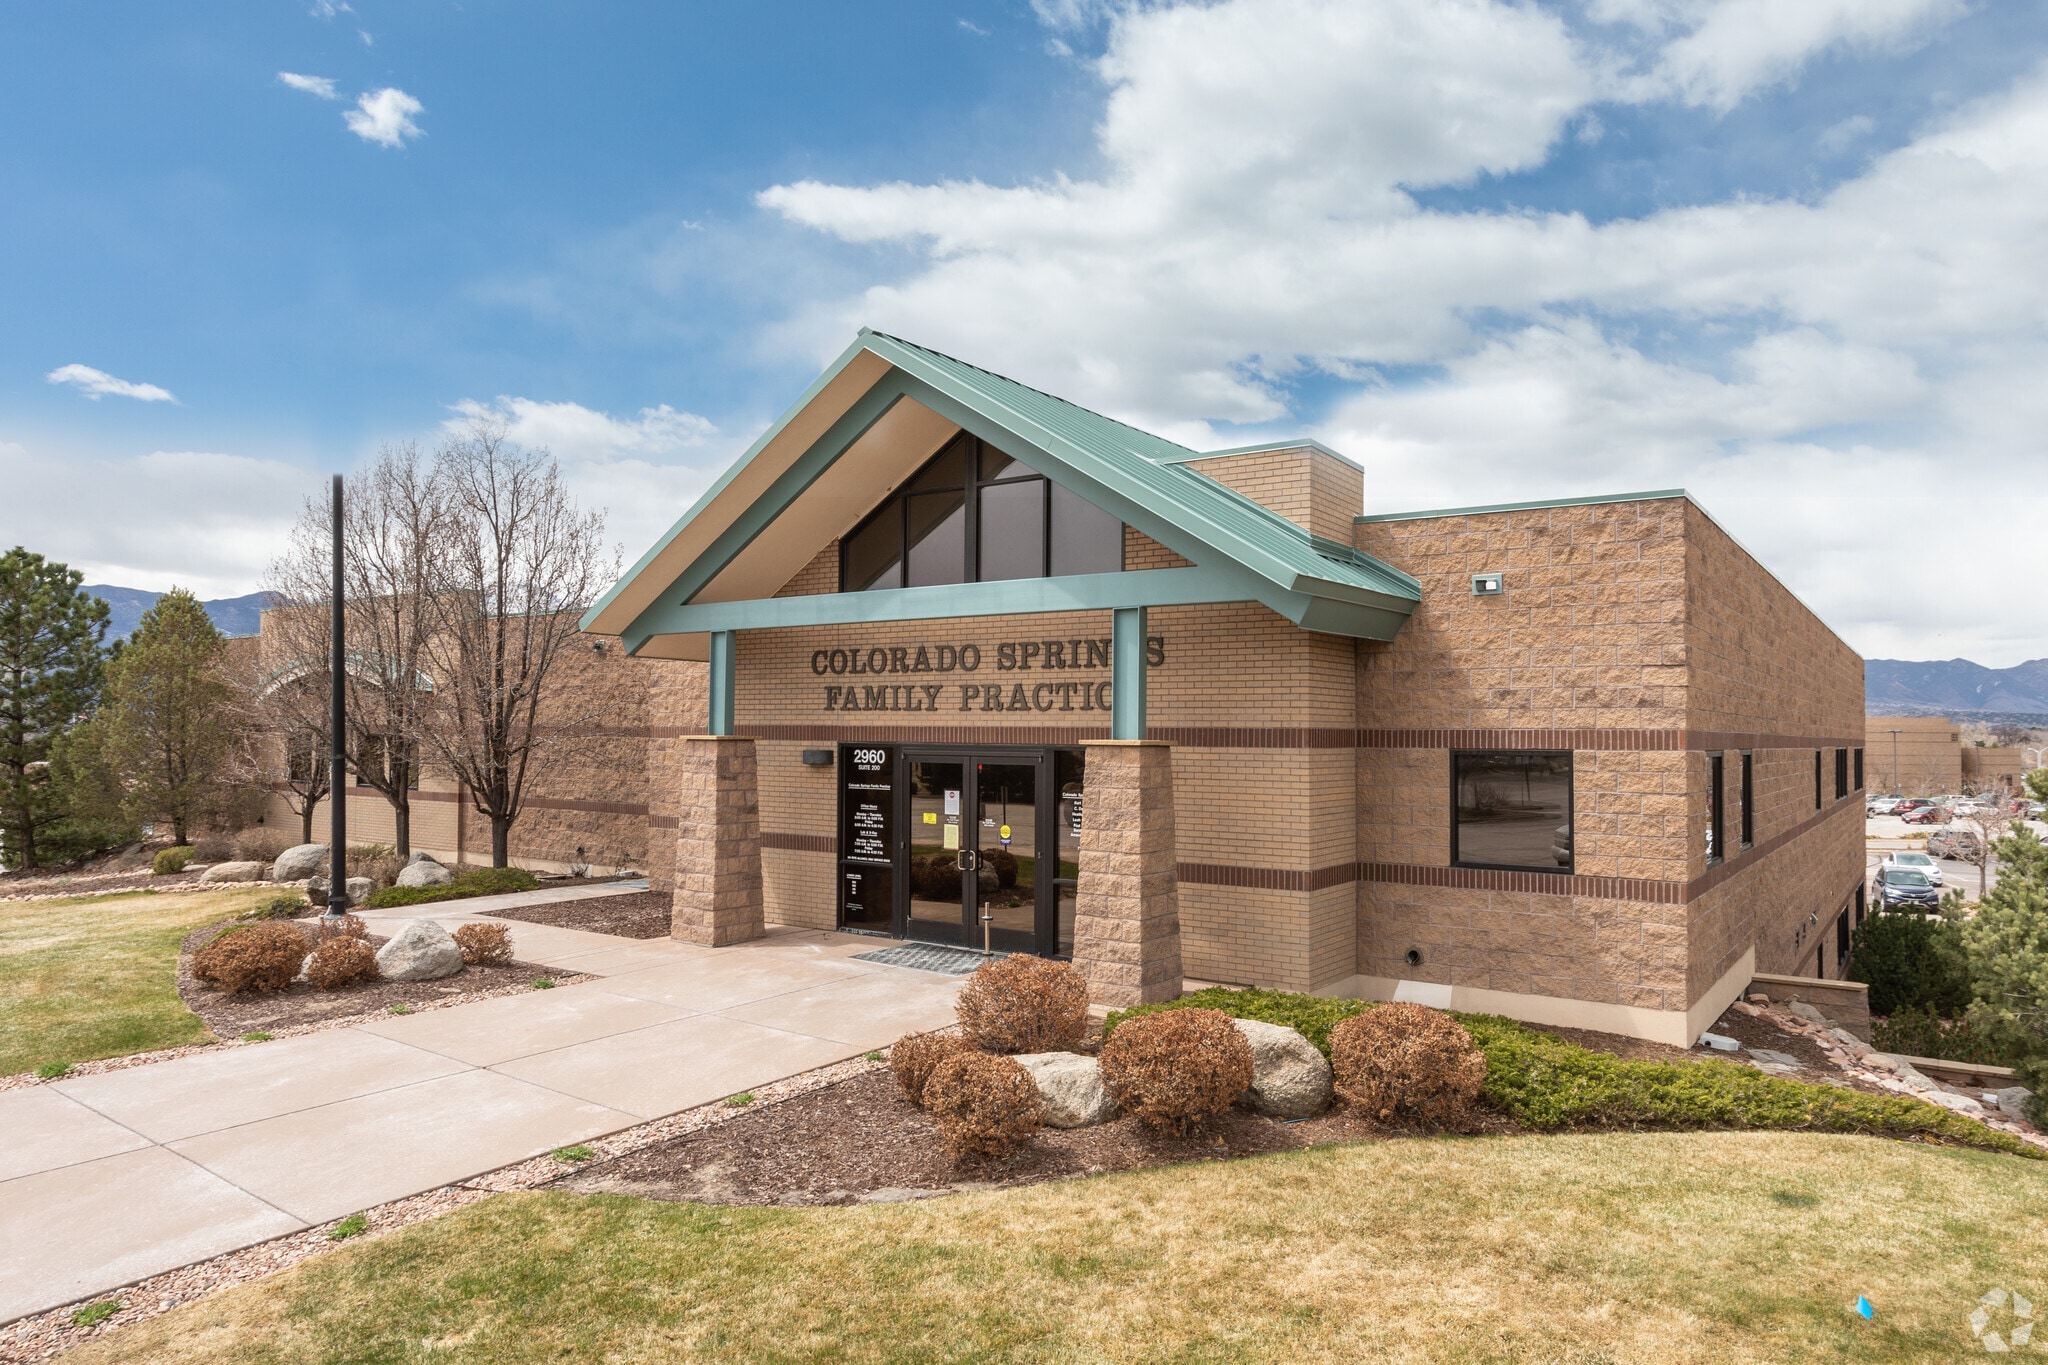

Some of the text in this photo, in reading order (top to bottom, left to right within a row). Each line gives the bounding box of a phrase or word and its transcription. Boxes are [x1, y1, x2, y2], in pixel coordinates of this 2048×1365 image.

[811, 636, 1165, 676] COLORADO SPRINS
[824, 681, 1112, 712] FAMILY PRACTIC
[853, 749, 886, 764] 2960
